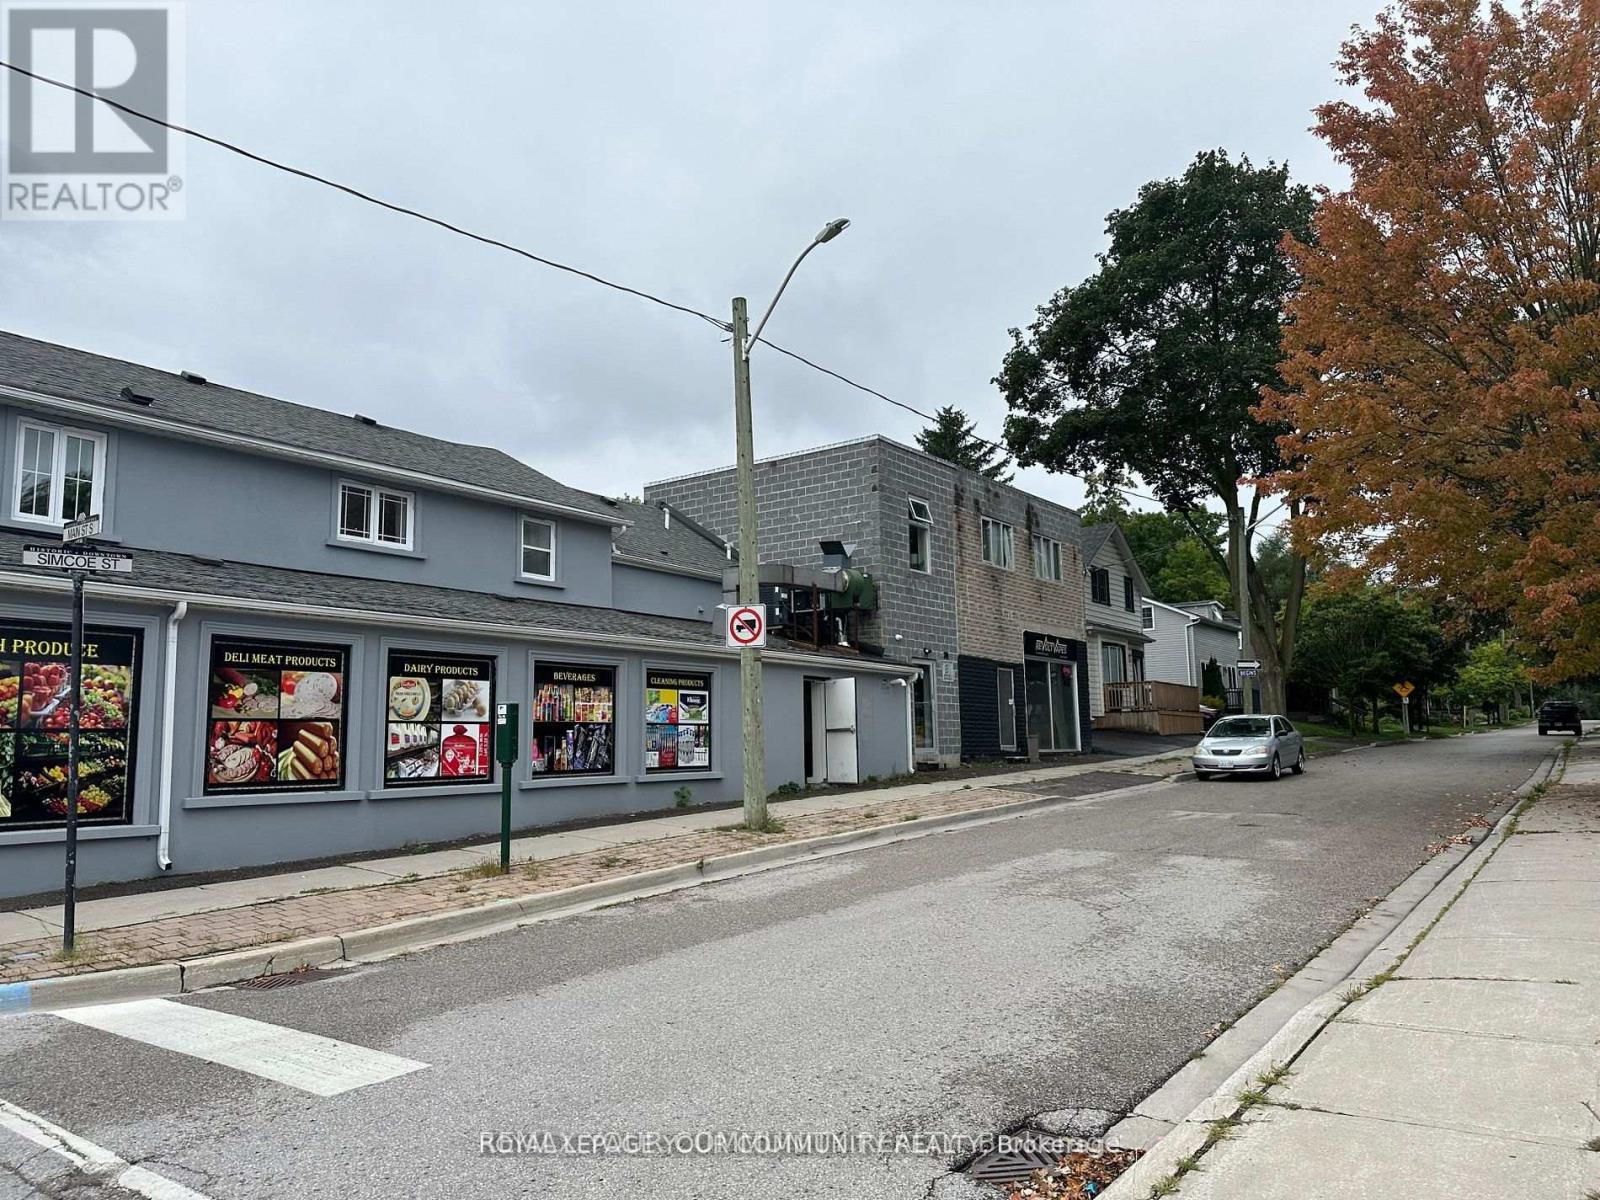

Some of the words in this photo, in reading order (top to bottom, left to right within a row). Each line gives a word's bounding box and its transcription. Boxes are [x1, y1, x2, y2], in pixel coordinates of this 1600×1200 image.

[68, 526, 80, 539] MAIN
[81, 524, 88, 536] ST
[89, 523, 93, 534] S
[83, 551, 127, 559] DOWNTOWN
[37, 553, 96, 569] SIMCOE
[101, 558, 120, 570] ST
[224, 652, 249, 663] DELI
[251, 654, 283, 665] MEAT
[285, 656, 336, 668] PRODUCTS
[404, 664, 434, 673] DAIRY
[435, 665, 479, 676] PRODUCTS
[553, 672, 596, 681] BEVERAGES
[650, 677, 677, 685] CLEANING
[678, 679, 704, 687] PRODUCTS
